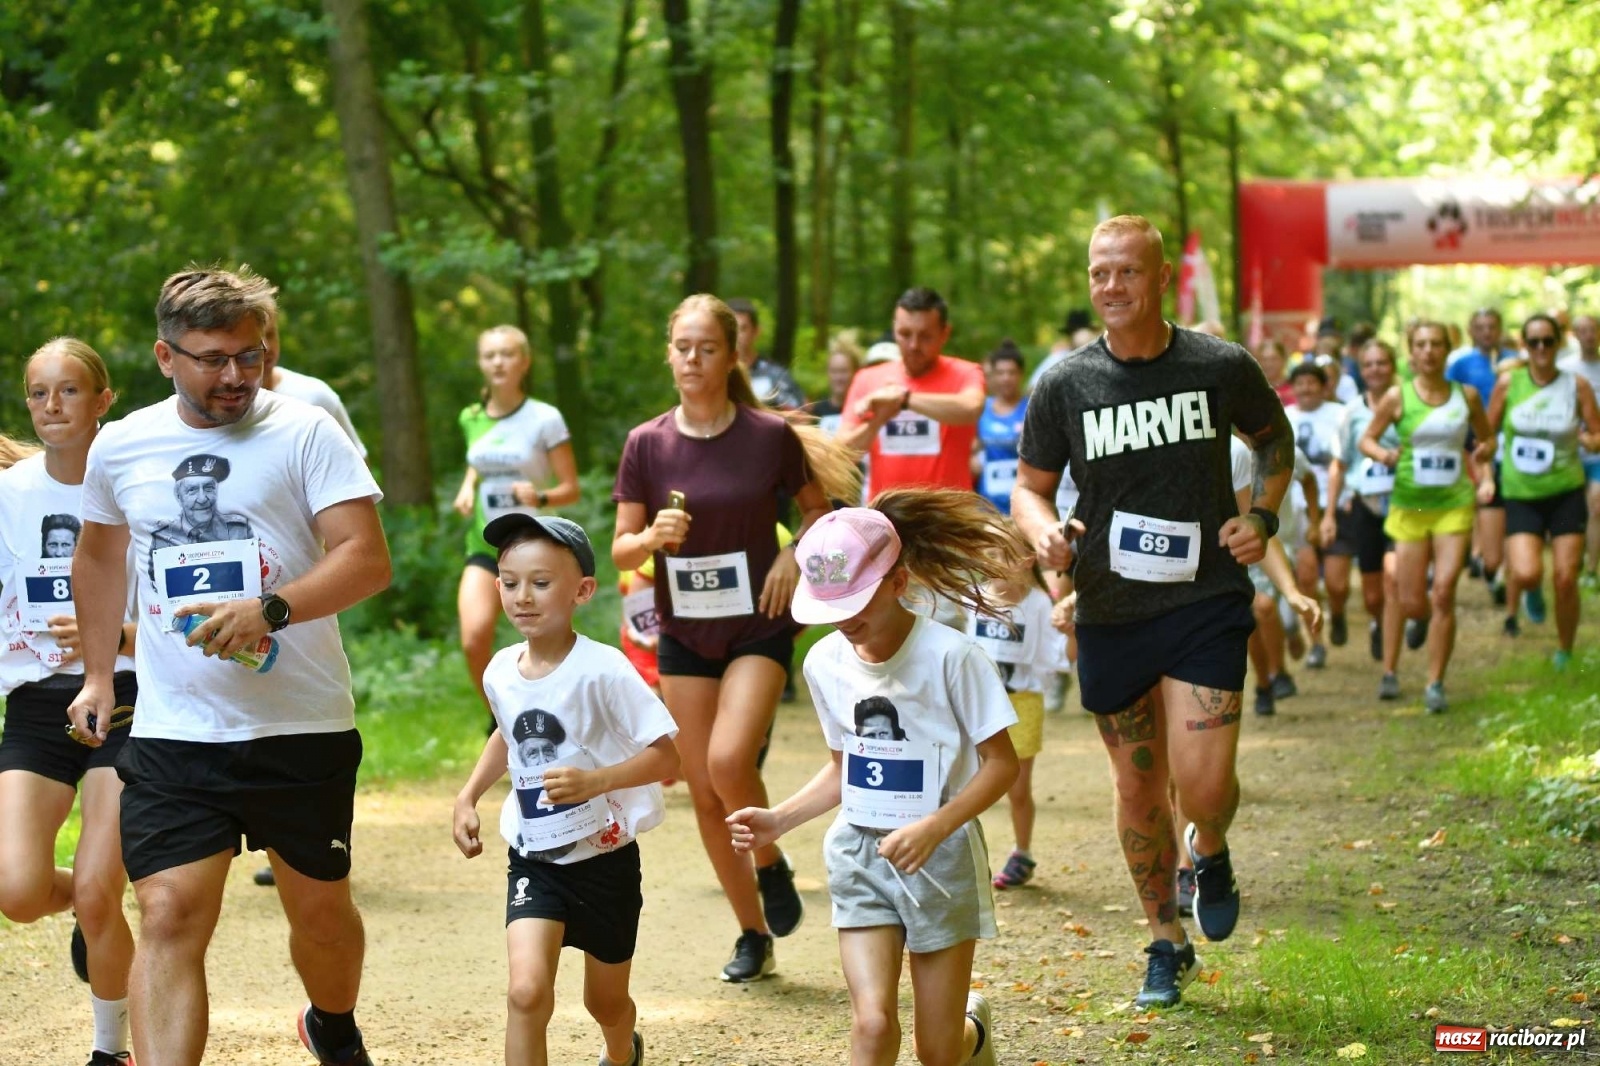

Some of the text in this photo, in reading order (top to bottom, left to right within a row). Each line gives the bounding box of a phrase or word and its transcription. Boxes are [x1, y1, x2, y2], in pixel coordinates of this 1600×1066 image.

[896, 421, 918, 435] 76
[1082, 390, 1217, 462] MARVEL
[1139, 533, 1170, 554] 69
[192, 567, 211, 591] 2
[690, 570, 720, 590] 95
[805, 552, 850, 586] 92
[52, 578, 70, 600] 8
[985, 622, 1009, 639] 66
[865, 761, 884, 787] 3
[536, 789, 555, 812] 4
